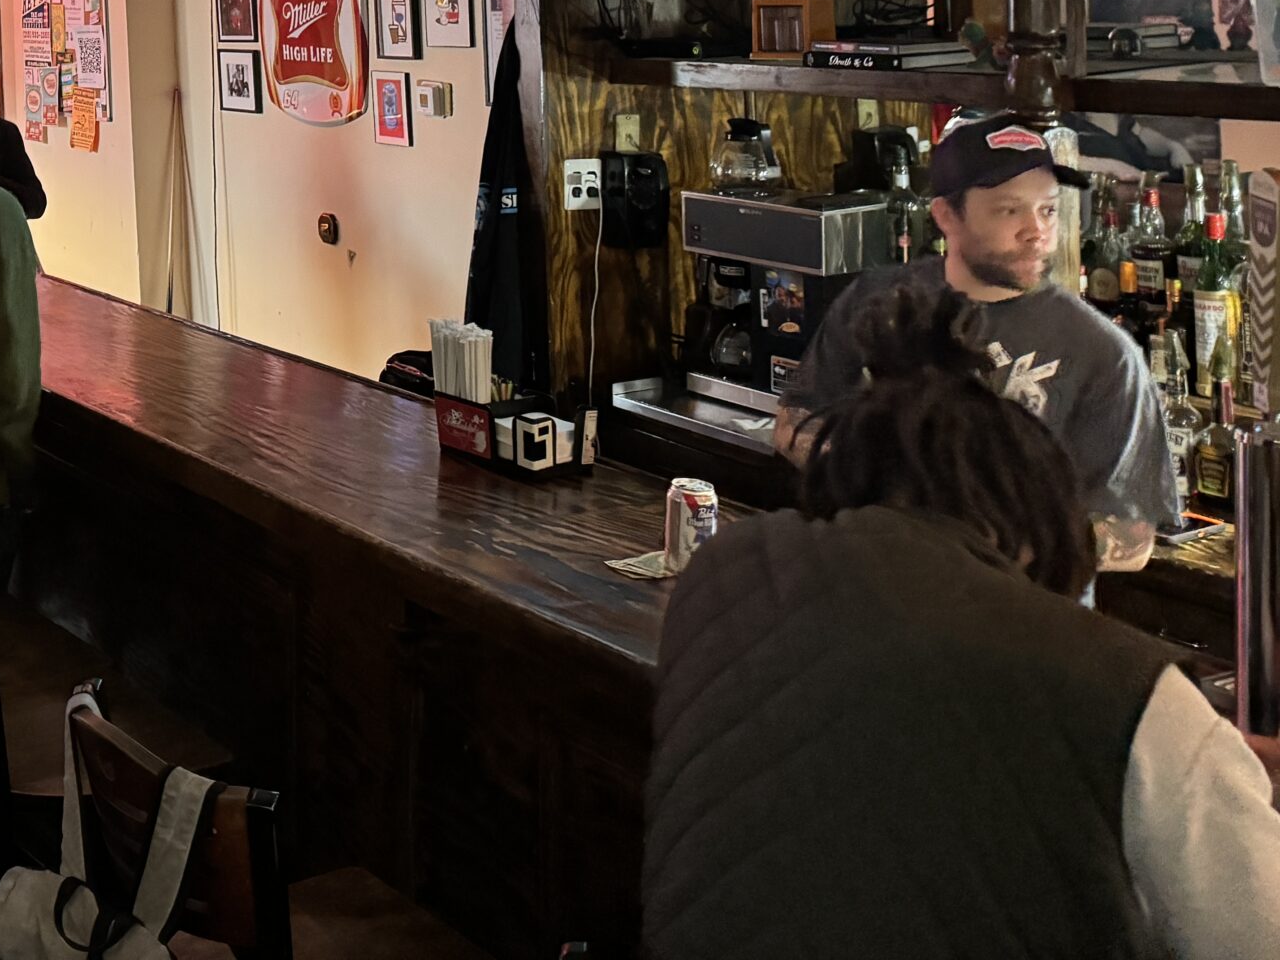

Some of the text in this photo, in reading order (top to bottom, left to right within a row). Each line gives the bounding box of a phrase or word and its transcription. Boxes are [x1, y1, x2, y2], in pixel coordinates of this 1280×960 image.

[282, 0, 328, 32] Miller
[282, 44, 334, 63] HIGH LIFE
[283, 89, 300, 109] 64
